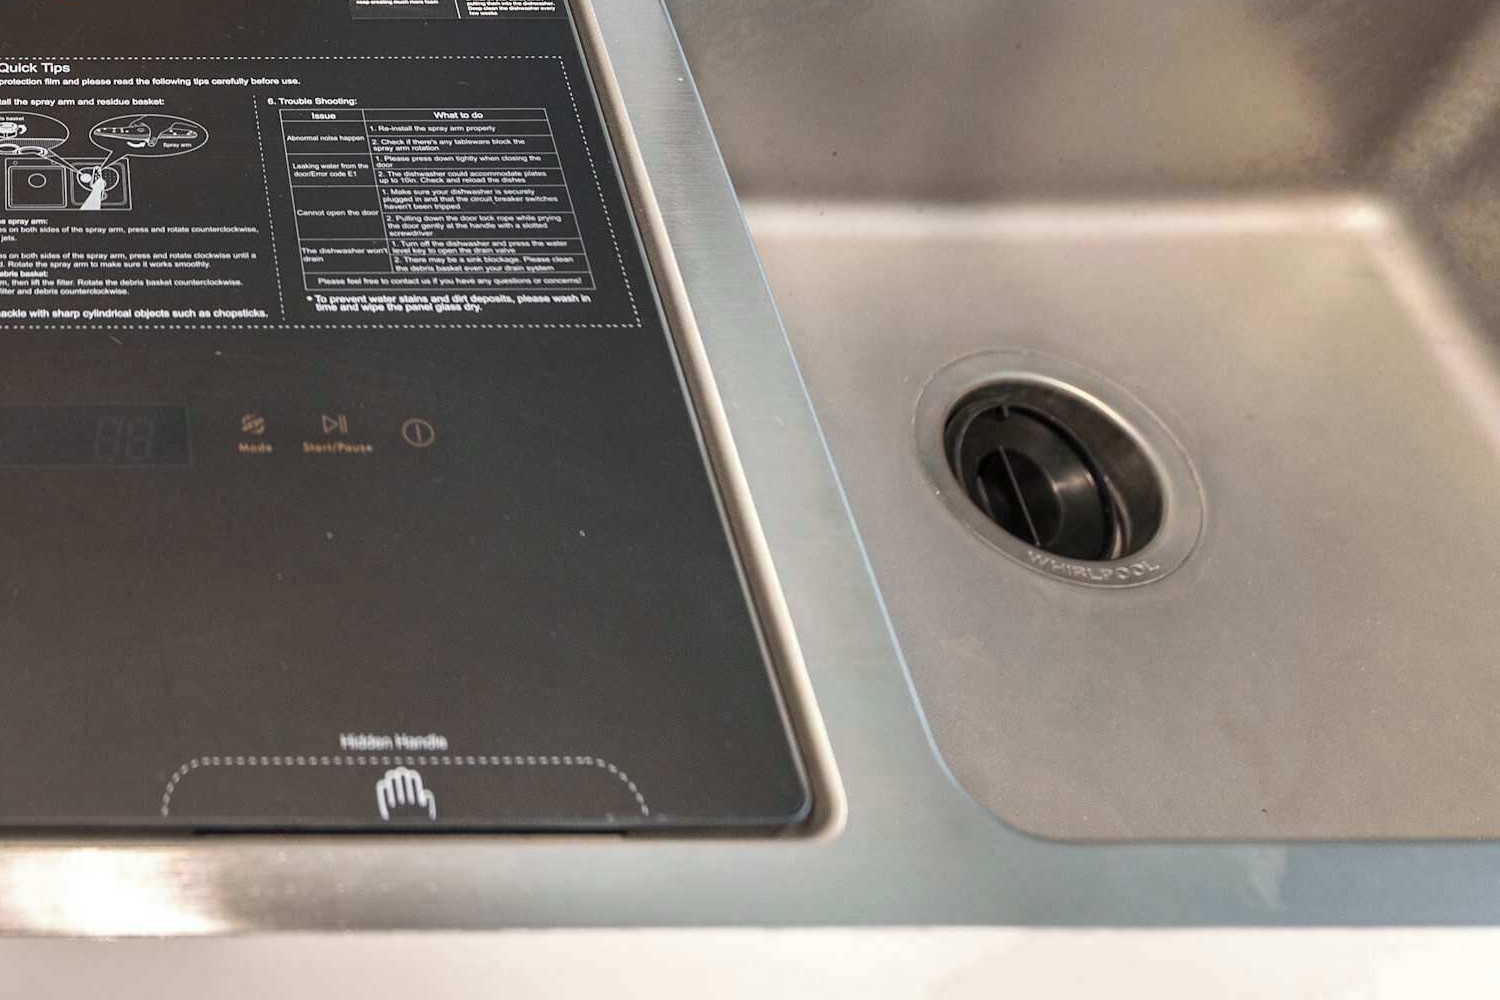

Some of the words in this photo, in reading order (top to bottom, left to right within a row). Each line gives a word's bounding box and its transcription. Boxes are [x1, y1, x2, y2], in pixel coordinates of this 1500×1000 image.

[41, 62, 70, 75] Tips
[81, 78, 111, 86] please
[152, 78, 191, 86] following
[193, 78, 209, 86] tips
[211, 77, 249, 86] carefully
[250, 77, 279, 85] before
[30, 99, 55, 107] spray
[279, 97, 313, 105] Trouble
[315, 97, 357, 106] Shooting:
[311, 112, 336, 120] Issue
[433, 111, 458, 119] What
[460, 111, 469, 119] to
[471, 111, 483, 119] do
[29, 309, 50, 318] with
[52, 309, 80, 320] sharp
[82, 309, 132, 320] cylindrical
[134, 308, 170, 320] objects
[172, 308, 196, 318] such
[198, 310, 211, 318] as
[213, 308, 268, 319] chopsticks.
[238, 442, 273, 452] Mode
[303, 441, 373, 453] Start/Pause
[1028, 551, 1161, 581] WHIRLPOOL
[394, 732, 448, 750] Handle
